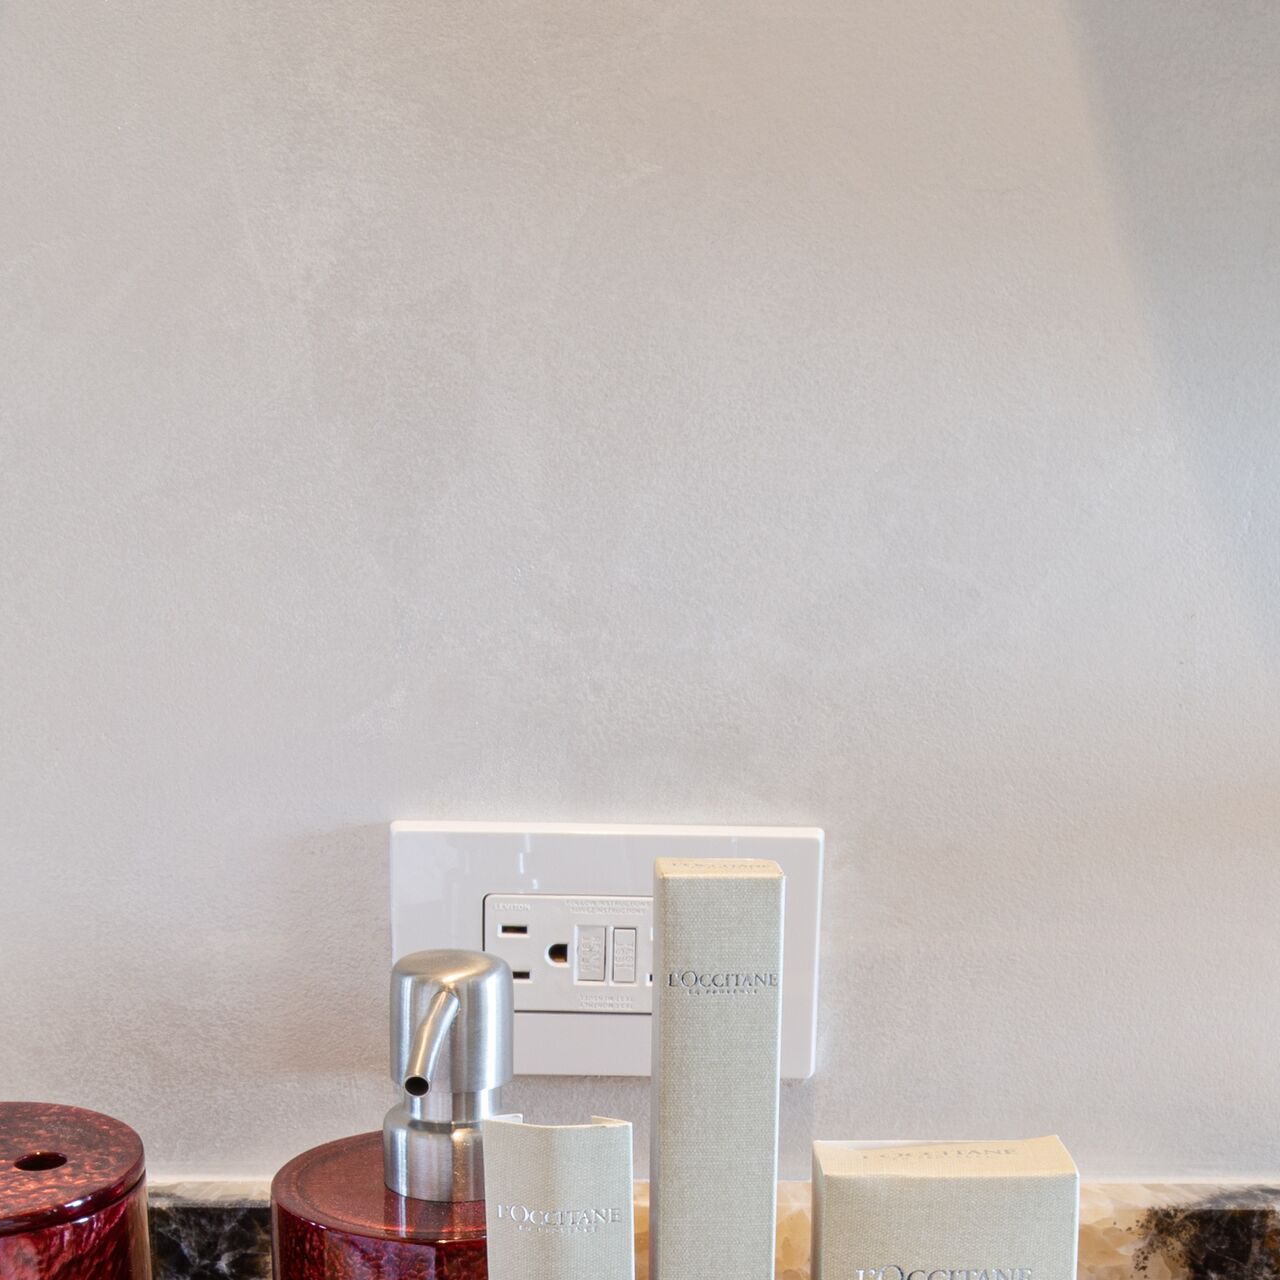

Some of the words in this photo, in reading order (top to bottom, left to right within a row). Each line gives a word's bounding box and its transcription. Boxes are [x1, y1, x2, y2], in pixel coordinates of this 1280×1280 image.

[494, 903, 531, 912] LEVITON
[668, 970, 778, 988] L'OCCITANE
[497, 1203, 621, 1225] L'OCCITANE
